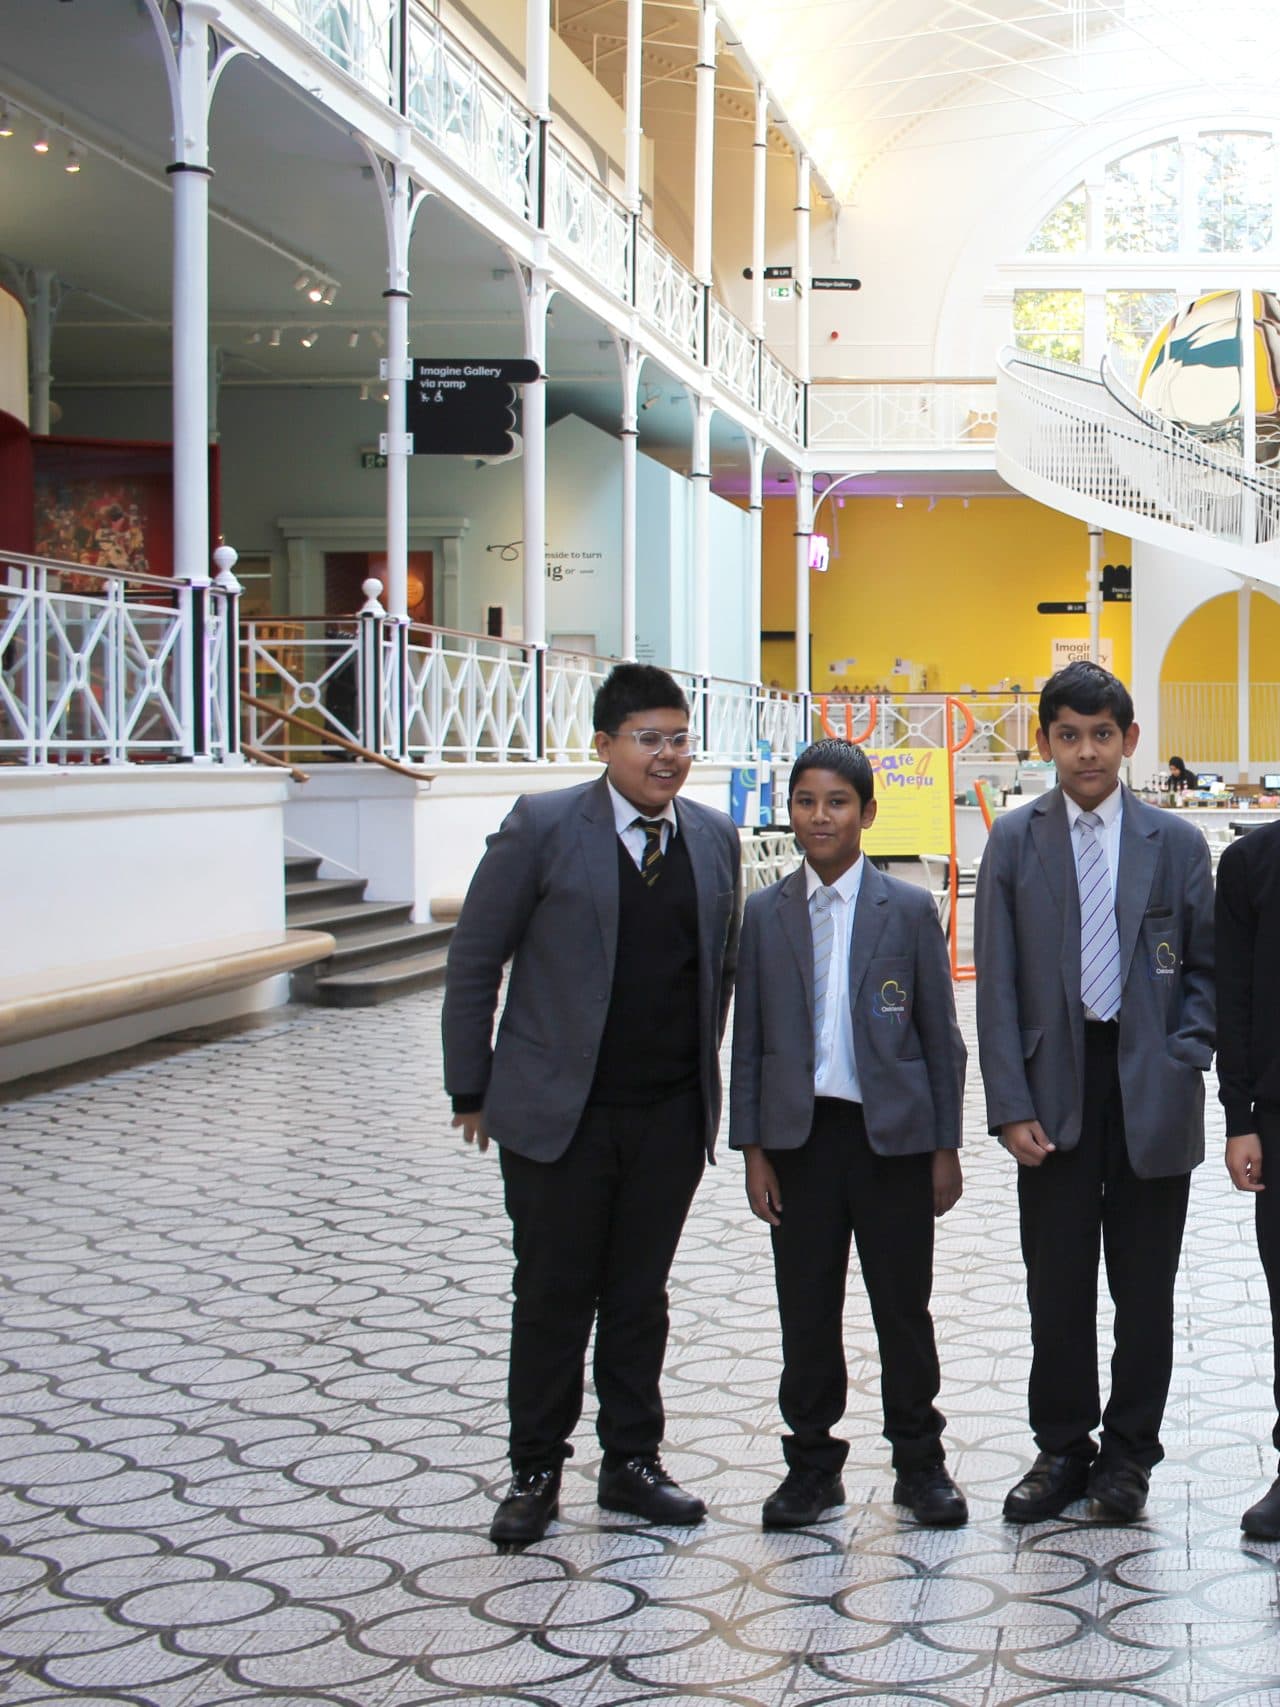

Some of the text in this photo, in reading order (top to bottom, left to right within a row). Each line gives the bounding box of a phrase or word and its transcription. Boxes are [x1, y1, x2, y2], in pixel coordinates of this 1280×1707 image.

[420, 366, 502, 378] Imagine Gallery
[420, 379, 467, 390] via ramp
[545, 563, 563, 581] ig
[1055, 643, 1090, 653] Imagi
[886, 772, 934, 788] Menu
